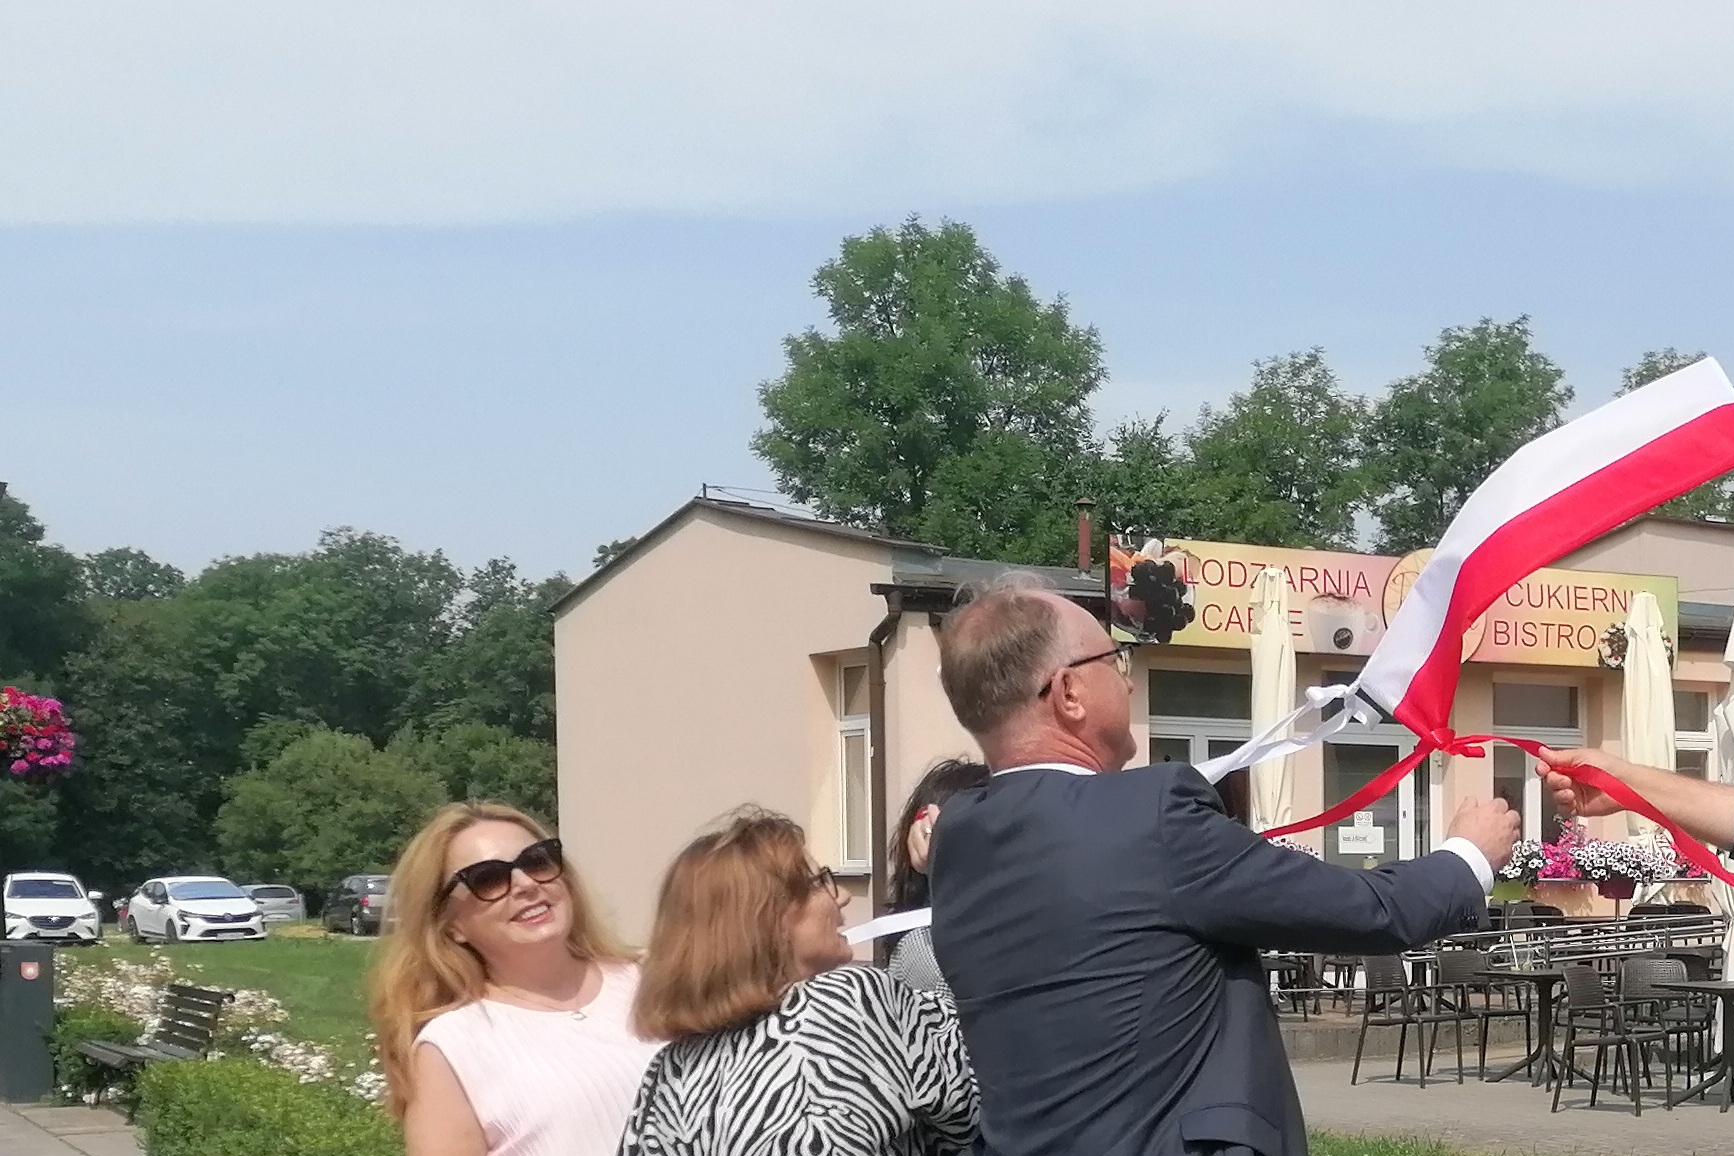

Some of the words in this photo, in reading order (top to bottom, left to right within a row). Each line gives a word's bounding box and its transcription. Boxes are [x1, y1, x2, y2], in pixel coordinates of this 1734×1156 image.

[1182, 557, 1372, 598] LODZARNIA
[1505, 581, 1647, 614] CUKIERN
[1494, 619, 1598, 651] BISTRO
